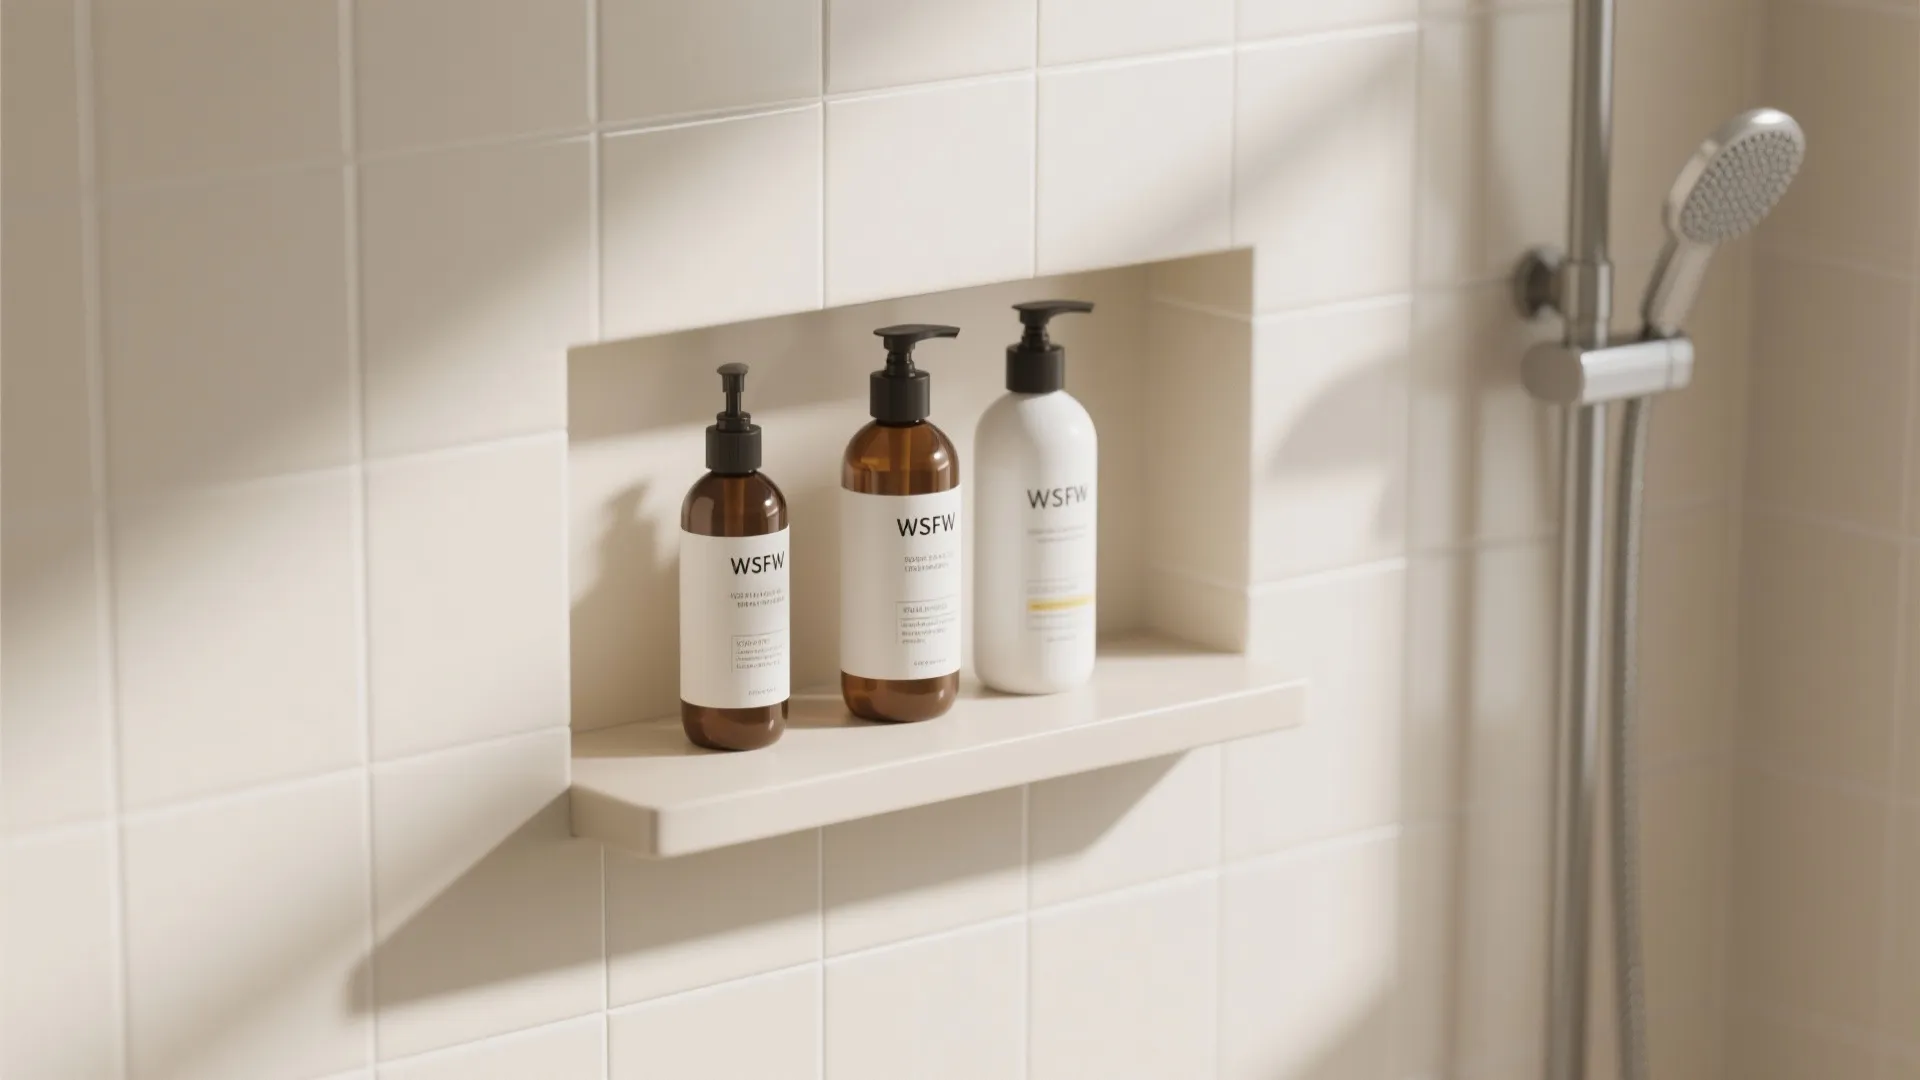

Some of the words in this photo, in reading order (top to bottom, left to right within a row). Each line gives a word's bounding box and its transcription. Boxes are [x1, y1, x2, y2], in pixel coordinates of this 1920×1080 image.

[1027, 486, 1087, 509] WSFW
[896, 512, 955, 537] WSFW
[731, 551, 785, 575] WSFW
